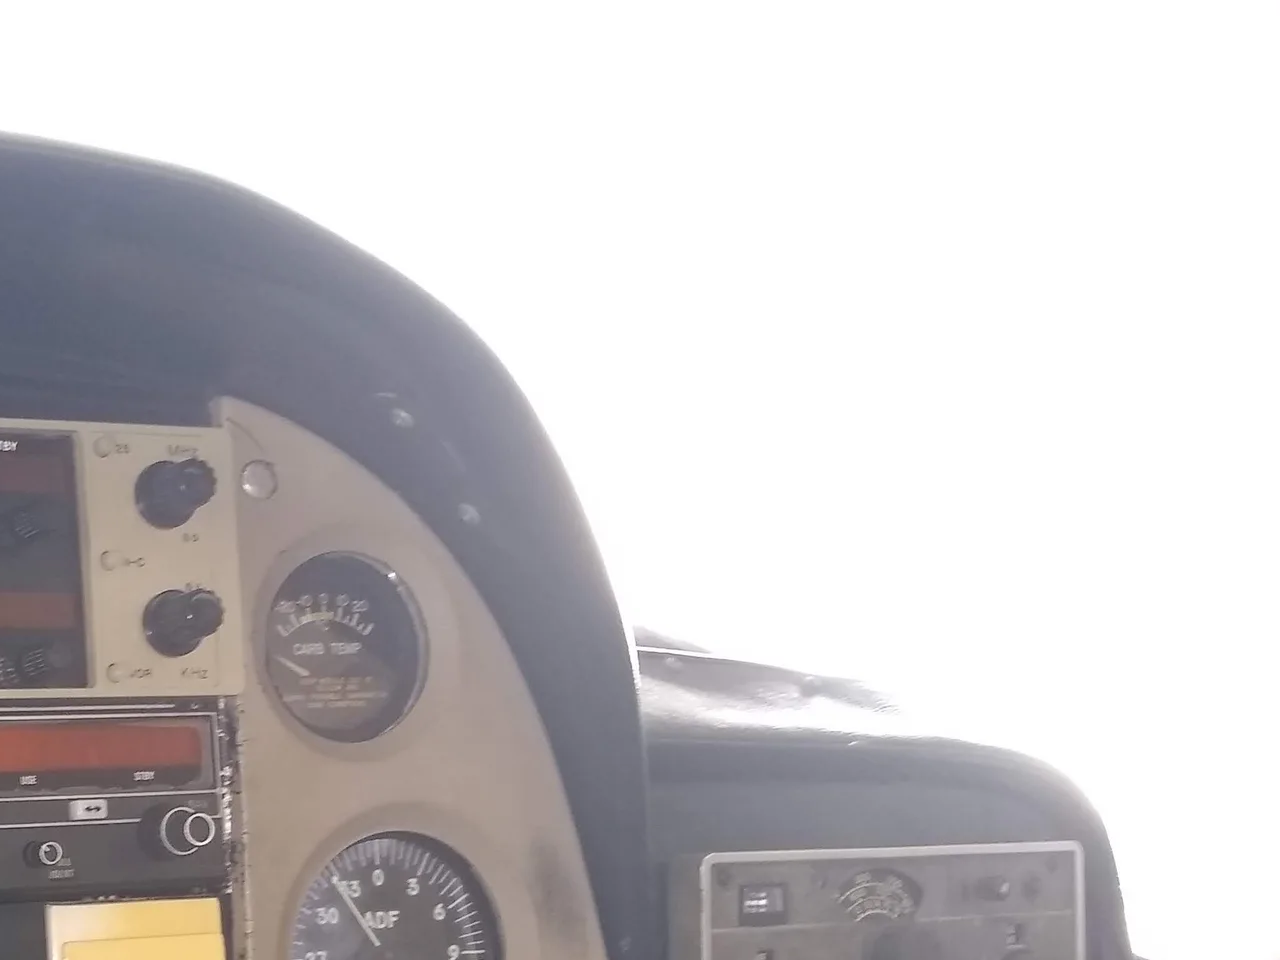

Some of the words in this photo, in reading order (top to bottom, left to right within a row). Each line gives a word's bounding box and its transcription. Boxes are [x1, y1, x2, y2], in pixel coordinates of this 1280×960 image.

[371, 868, 386, 886] 0
[405, 878, 421, 896] 3
[316, 907, 340, 925] 30
[432, 902, 447, 921] 6
